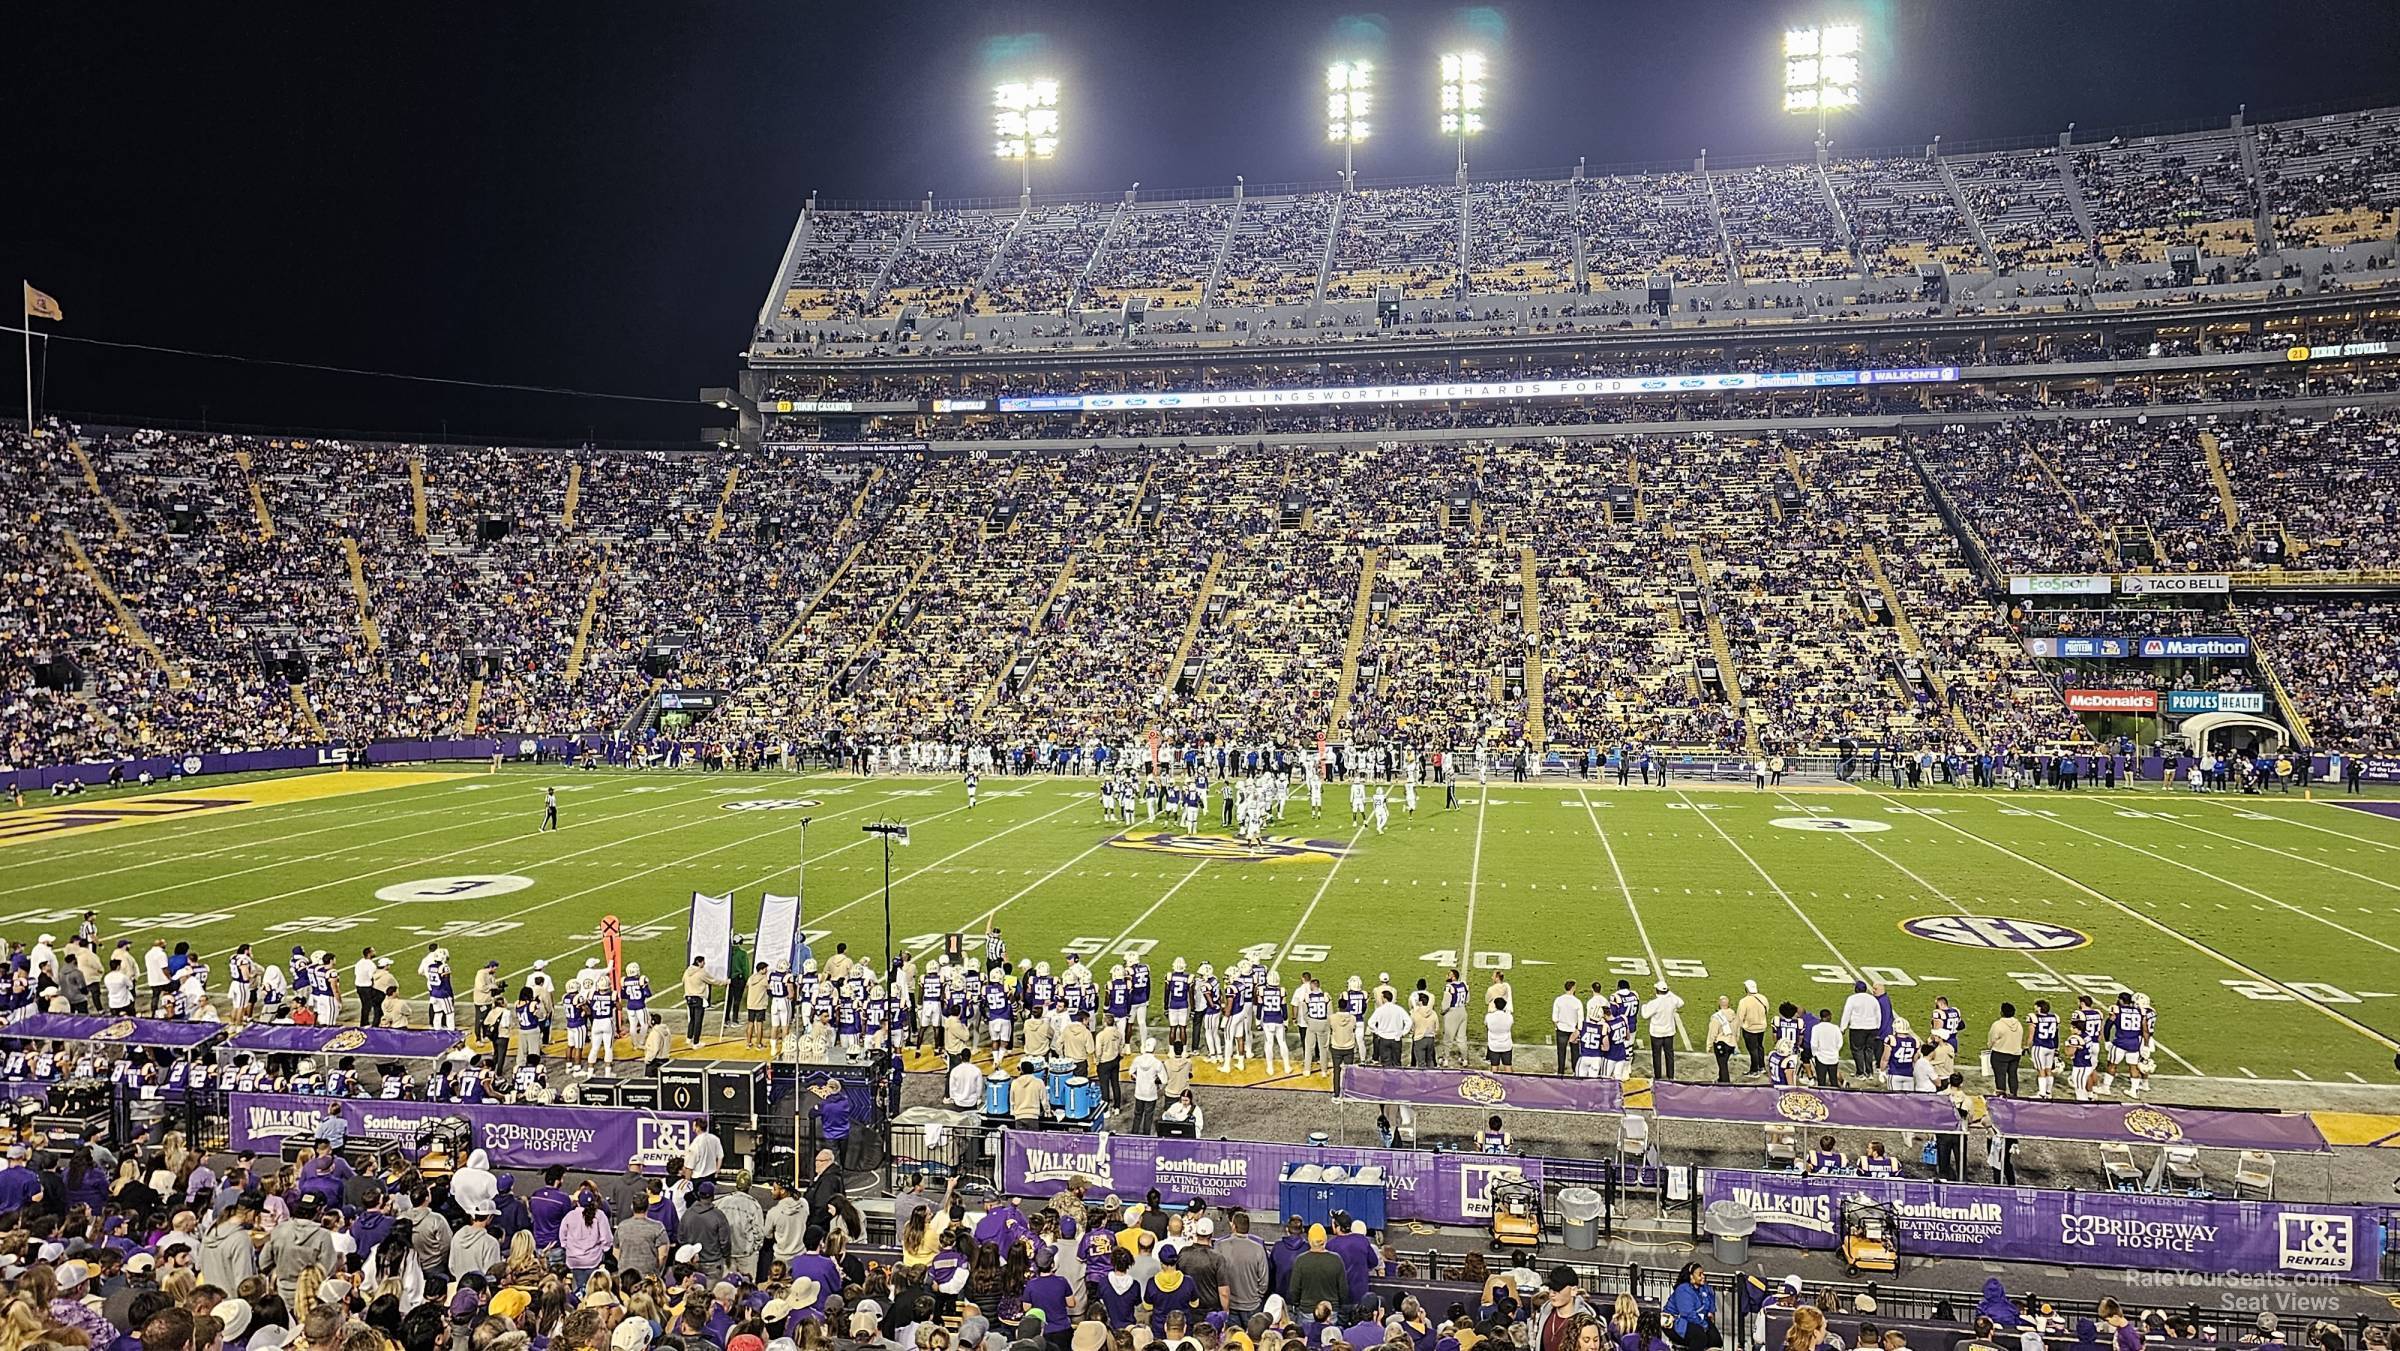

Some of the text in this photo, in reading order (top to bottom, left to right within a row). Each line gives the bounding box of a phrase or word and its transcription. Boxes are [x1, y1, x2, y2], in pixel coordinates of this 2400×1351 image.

[2293, 350, 2304, 358] 21
[2343, 342, 2387, 355] STOVALL
[1203, 381, 1621, 404] HOLLINGSWORTH RICHARDS FORD
[2029, 577, 2090, 592] EcoSport
[2149, 579, 2223, 590] TACO BELL
[2064, 643, 2092, 652] PROTEIN
[2167, 640, 2246, 654] Marathon
[2070, 695, 2154, 707] McDonald's
[2173, 695, 2260, 708] PEOPLES HEALTH
[1912, 917, 2080, 948] SEC
[1061, 937, 1159, 955] 50
[1238, 943, 1332, 962] 45
[1419, 949, 1513, 970] 40
[1607, 956, 1709, 977] 35
[1802, 964, 1918, 986] 30
[2007, 971, 2135, 994] 25
[625, 985, 641, 1000] 46
[924, 983, 941, 997] 25
[1035, 984, 1052, 999] 96
[1115, 989, 1124, 1004] 6
[1174, 982, 1182, 997] 2
[2219, 979, 2363, 1003] 20
[592, 1001, 610, 1016] 45
[987, 993, 1005, 1009] 95
[1264, 997, 1280, 1011] 59
[1309, 1003, 1326, 1018] 28
[2086, 1021, 2100, 1035] 97
[2120, 1014, 2141, 1030] 68
[2038, 1023, 2056, 1039] 54
[1582, 1032, 1600, 1048] 45
[1895, 1047, 1915, 1062] 42
[383, 1081, 401, 1099] 25
[461, 1077, 479, 1096] 17
[509, 1124, 596, 1143] BRIDGEWAY
[524, 1139, 578, 1152] HOSPICE
[1155, 1156, 1247, 1175] SouthernAIR
[1155, 1174, 1247, 1188] HEATING, COOLING
[1181, 1186, 1230, 1196] PLUMBING
[1893, 1200, 2003, 1222] SouthernAIR
[1950, 1223, 2002, 1235] COOLING
[2093, 1215, 2219, 1242] BRIDGEWAY
[2286, 1218, 2347, 1253] H&E
[1913, 1231, 1983, 1244] & PLUMBING
[2117, 1235, 2194, 1252] HOSPICE
[2286, 1255, 2346, 1267] RENTALS
